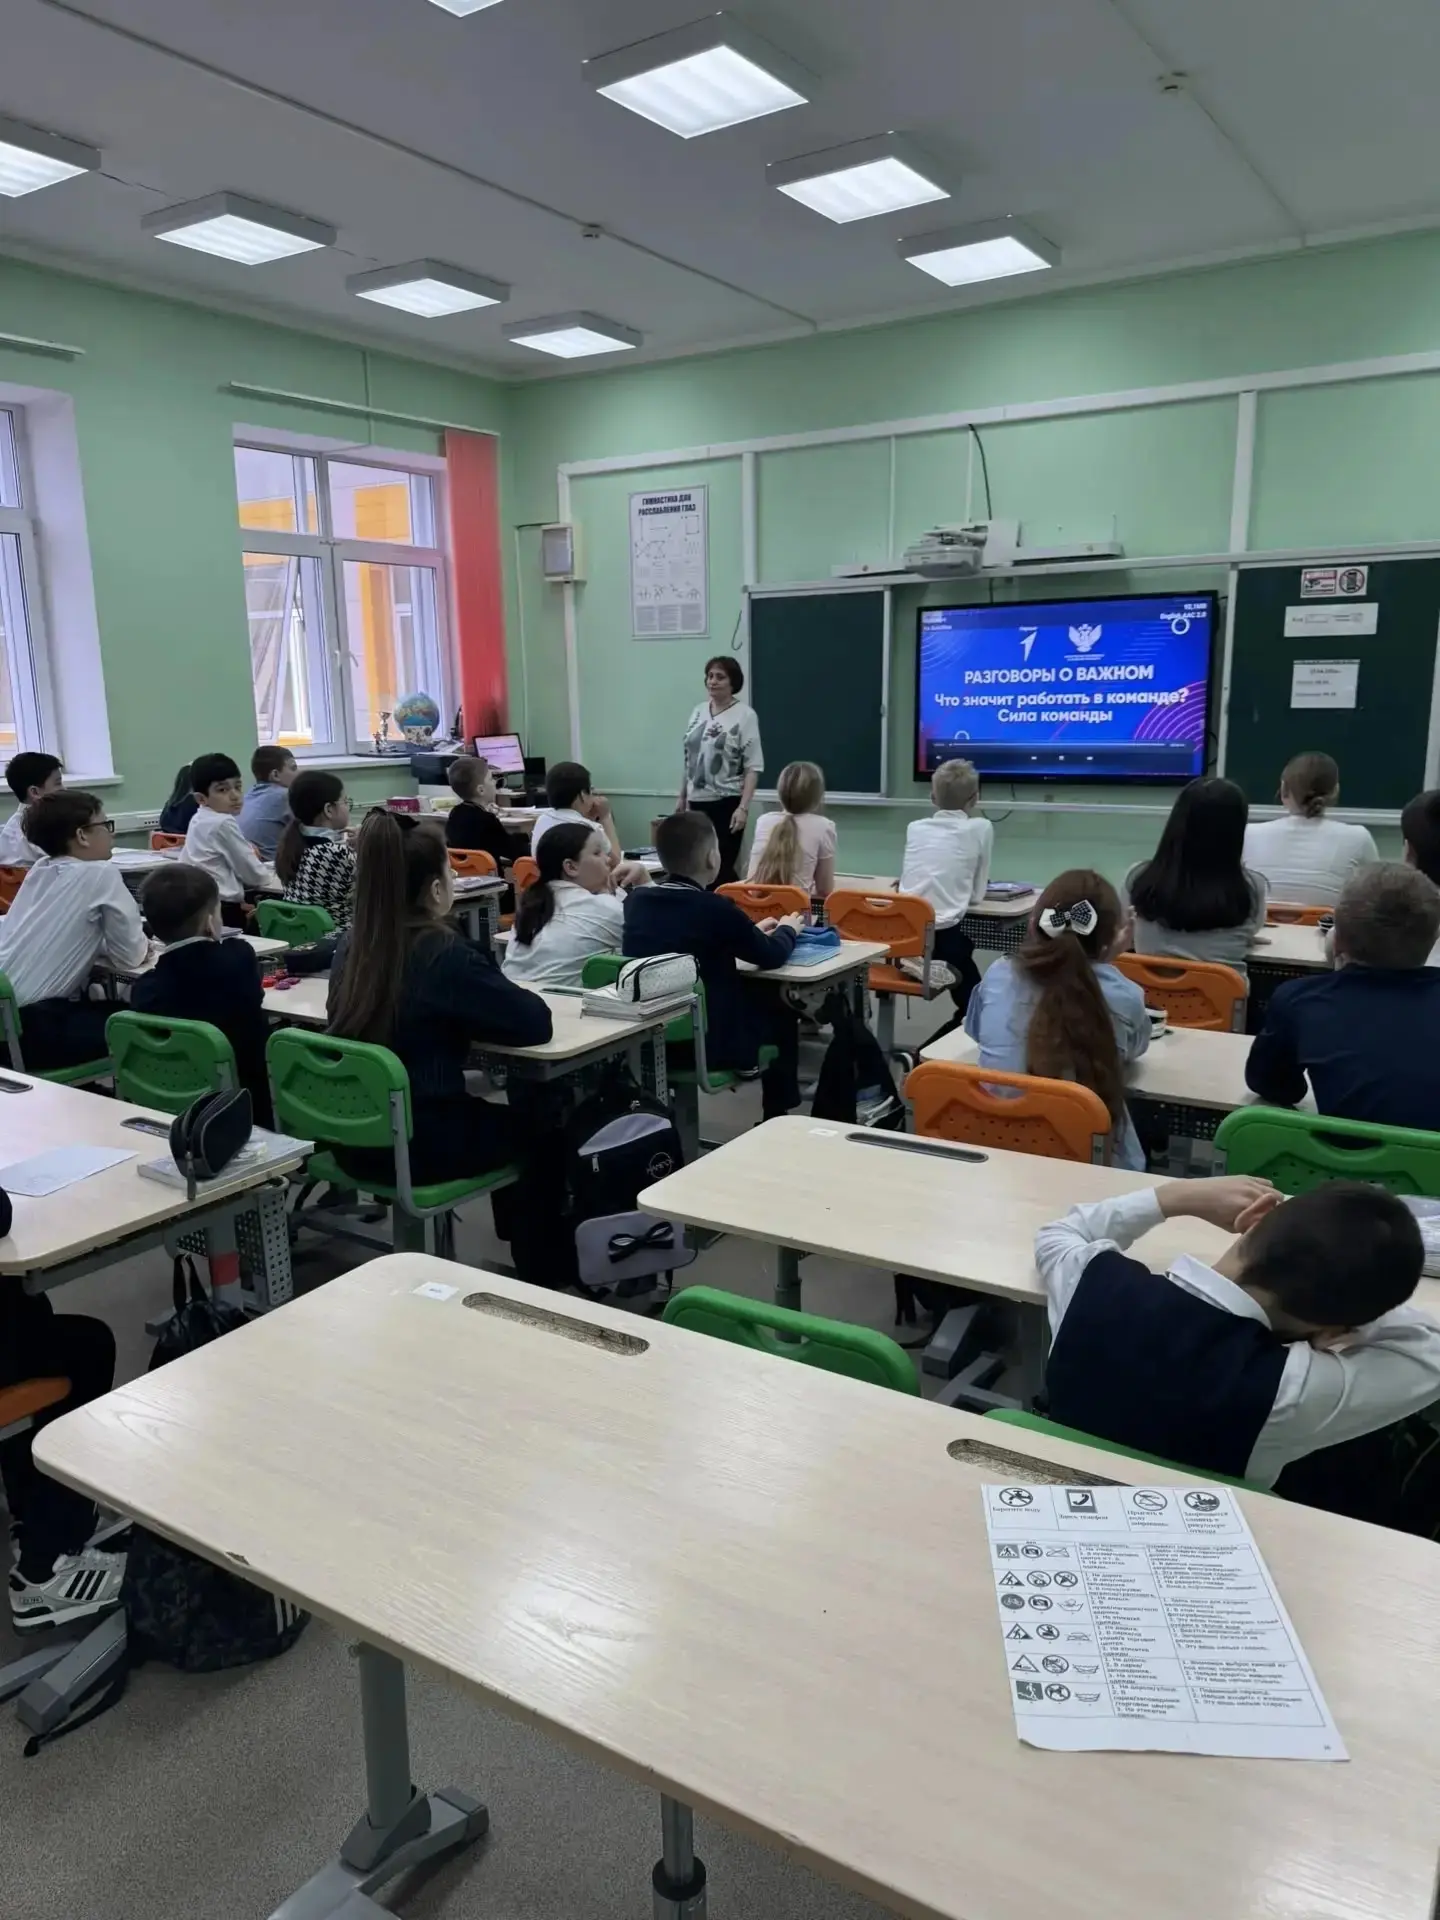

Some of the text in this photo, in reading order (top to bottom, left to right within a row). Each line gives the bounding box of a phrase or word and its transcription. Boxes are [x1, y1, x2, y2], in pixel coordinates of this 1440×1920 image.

[682, 504, 696, 512] ГЛАЗ
[964, 665, 1154, 684] РАЗГОВОРЫ О ВАЖНОМ
[935, 687, 1189, 708] Что значит работать в команде?
[998, 708, 1112, 723] Сила команды
